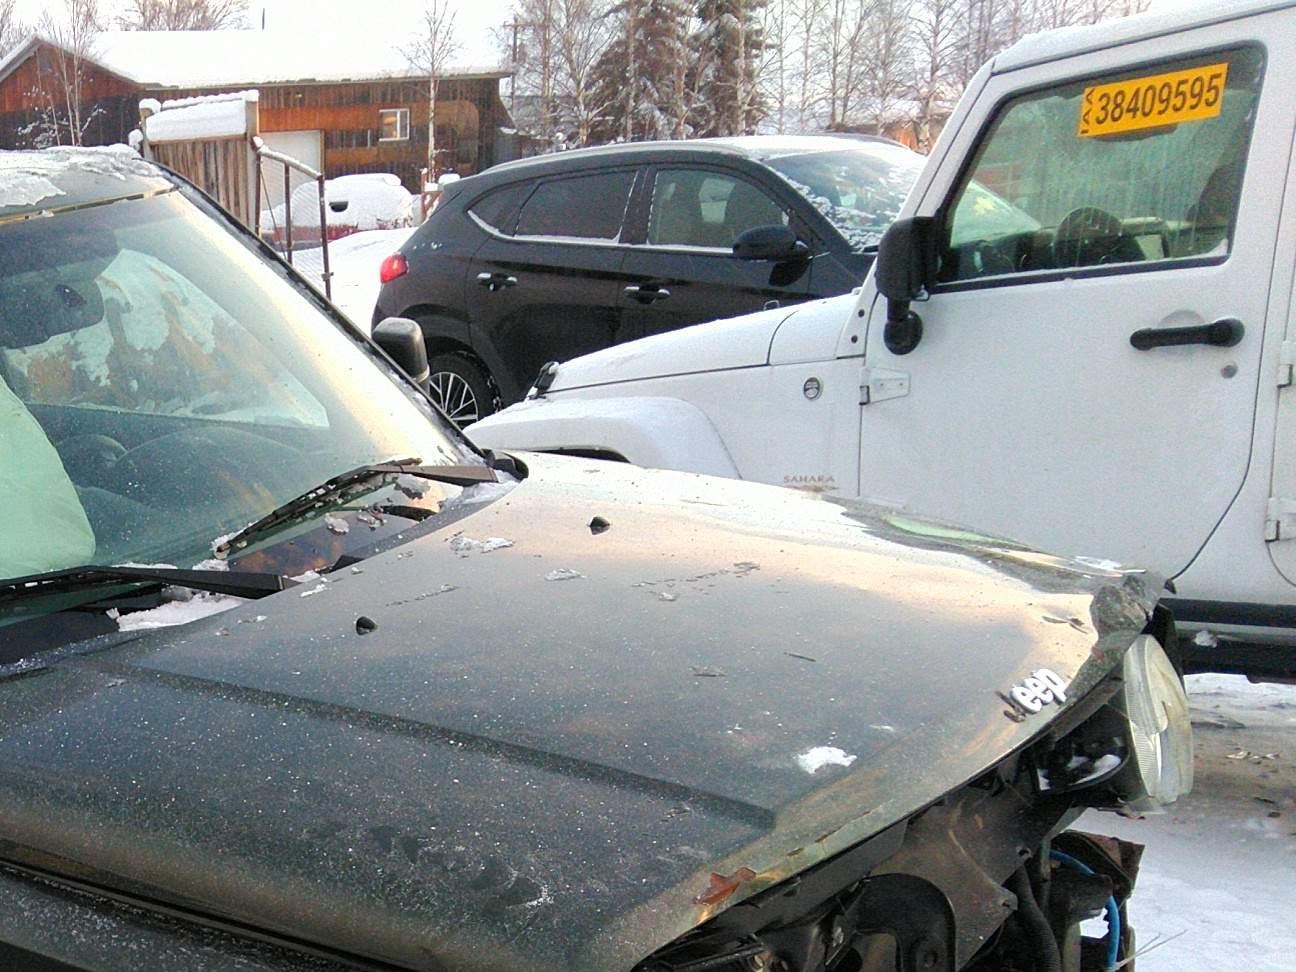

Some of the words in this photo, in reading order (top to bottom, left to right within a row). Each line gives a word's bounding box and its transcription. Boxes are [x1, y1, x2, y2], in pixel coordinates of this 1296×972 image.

[1080, 88, 1096, 134] IAA
[1095, 73, 1222, 124] 38409595
[783, 475, 836, 483] SAHARA
